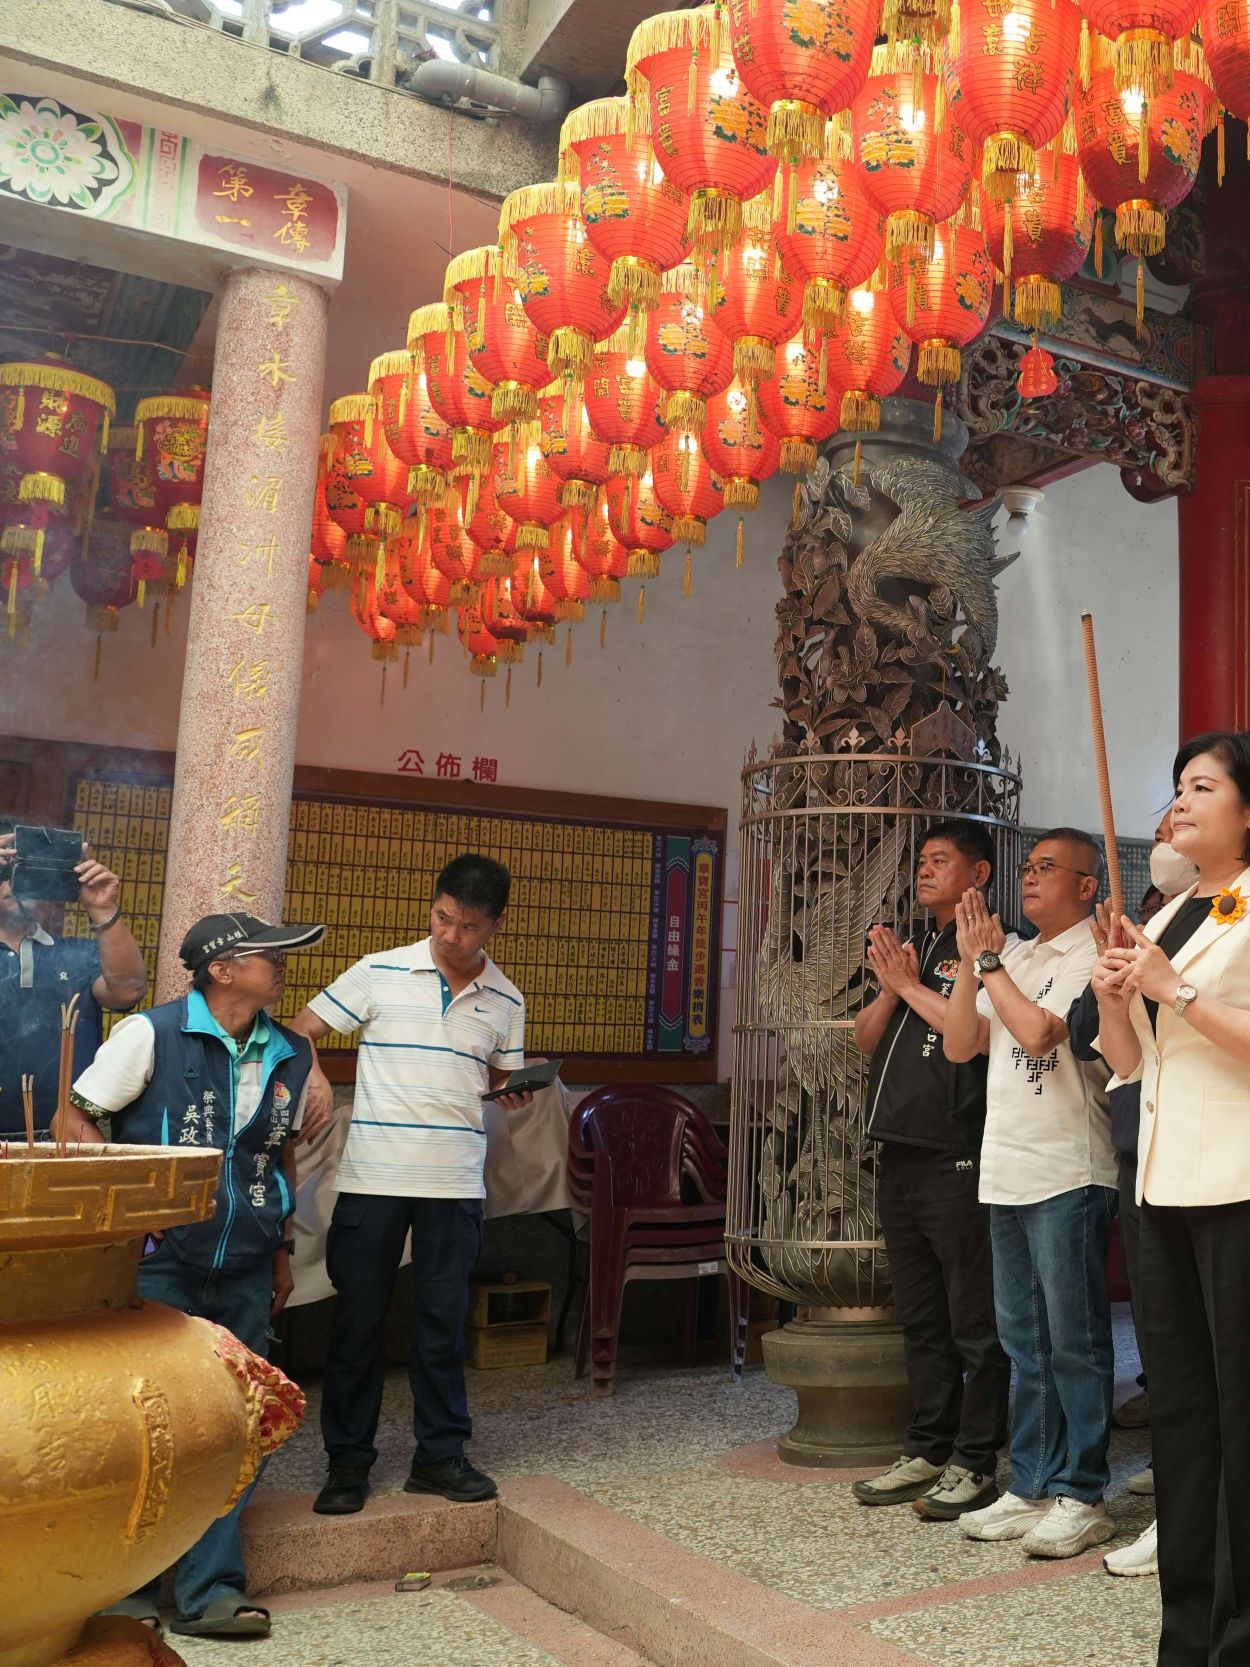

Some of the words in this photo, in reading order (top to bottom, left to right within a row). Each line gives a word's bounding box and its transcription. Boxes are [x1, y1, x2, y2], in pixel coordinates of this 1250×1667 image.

[1101, 97, 1132, 165] 富貴
[397, 749, 498, 782] 公佈欄
[666, 914, 680, 972] 自由緣金
[248, 1123, 287, 1208] 章寶宮
[955, 1159, 973, 1168] FILA
